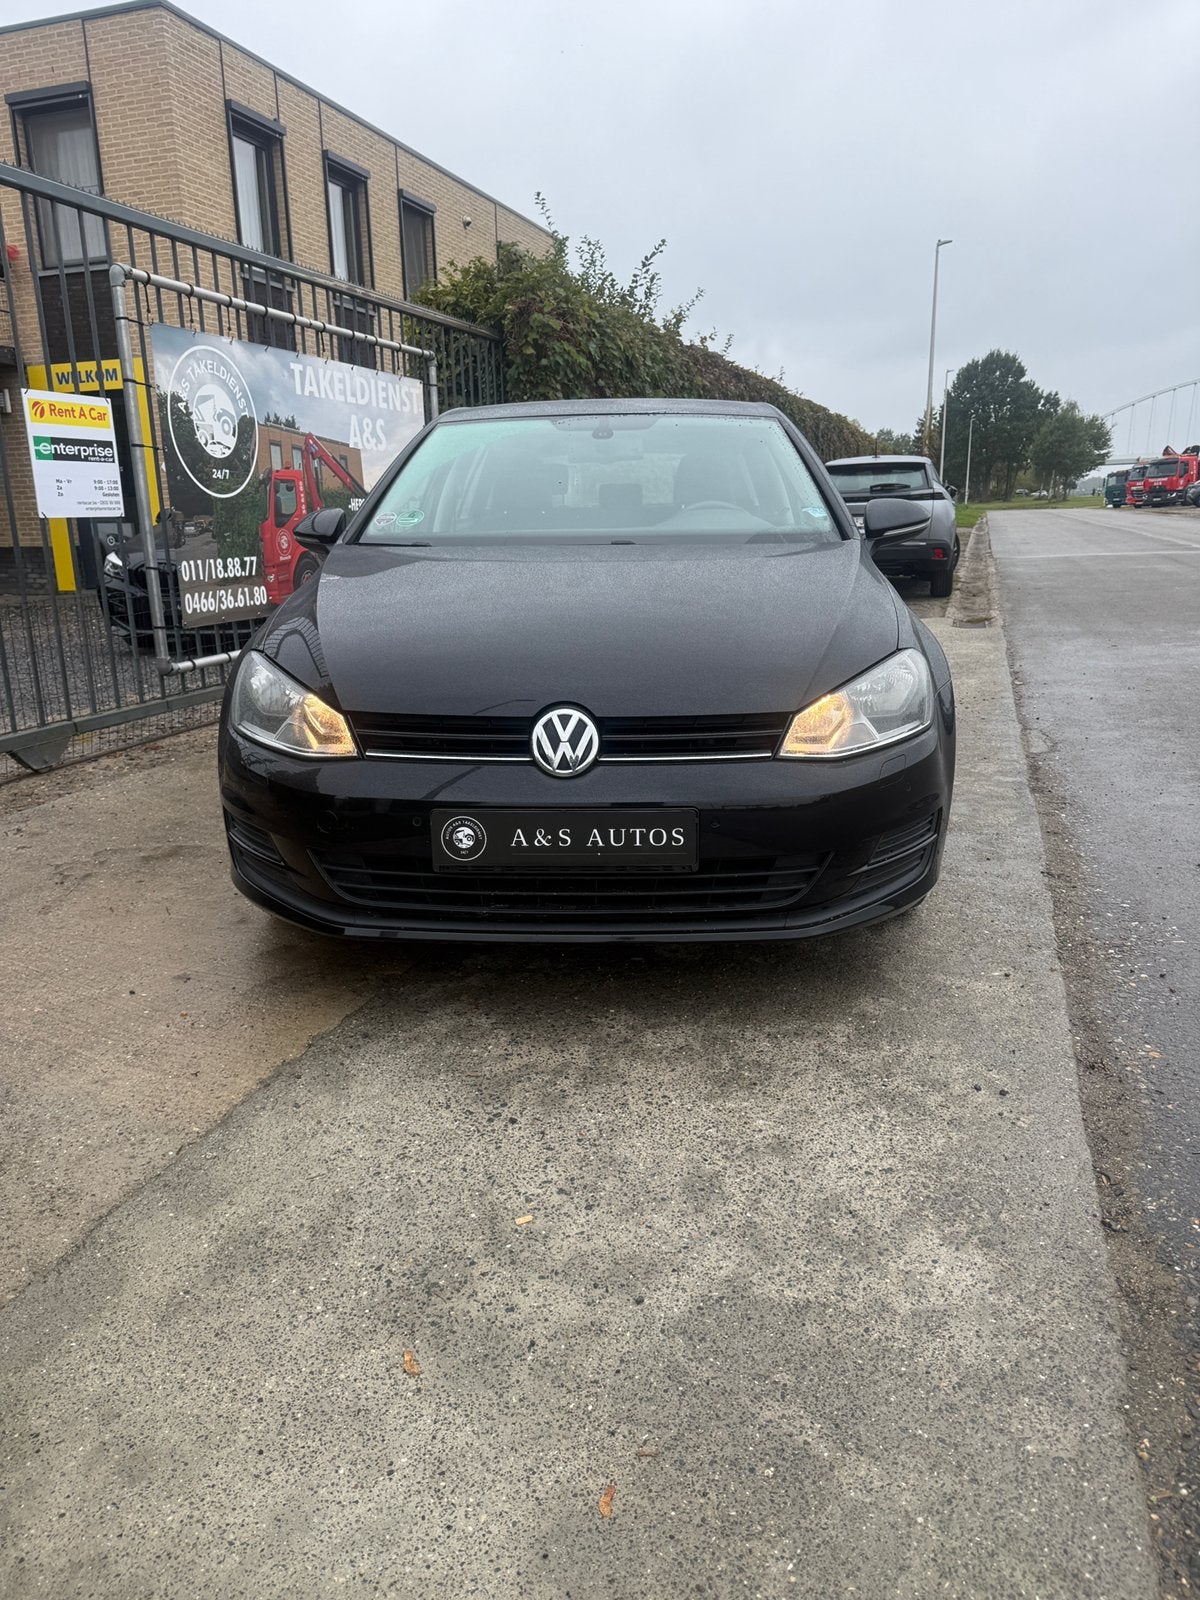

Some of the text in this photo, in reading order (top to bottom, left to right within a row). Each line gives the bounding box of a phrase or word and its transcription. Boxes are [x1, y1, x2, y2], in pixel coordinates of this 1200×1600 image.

[55, 367, 118, 385] WLKM
[186, 359, 250, 419] TAKELDIENST
[290, 362, 420, 415] TAKELDIENST
[48, 403, 107, 421] Rent A Car
[349, 414, 387, 450] A&S
[38, 442, 113, 459] enterprise
[212, 468, 230, 480] 24/7
[181, 556, 257, 582] 011/18.88.77
[184, 585, 268, 614] 0466/36.61.80
[510, 827, 685, 847] A&S AUTOS
